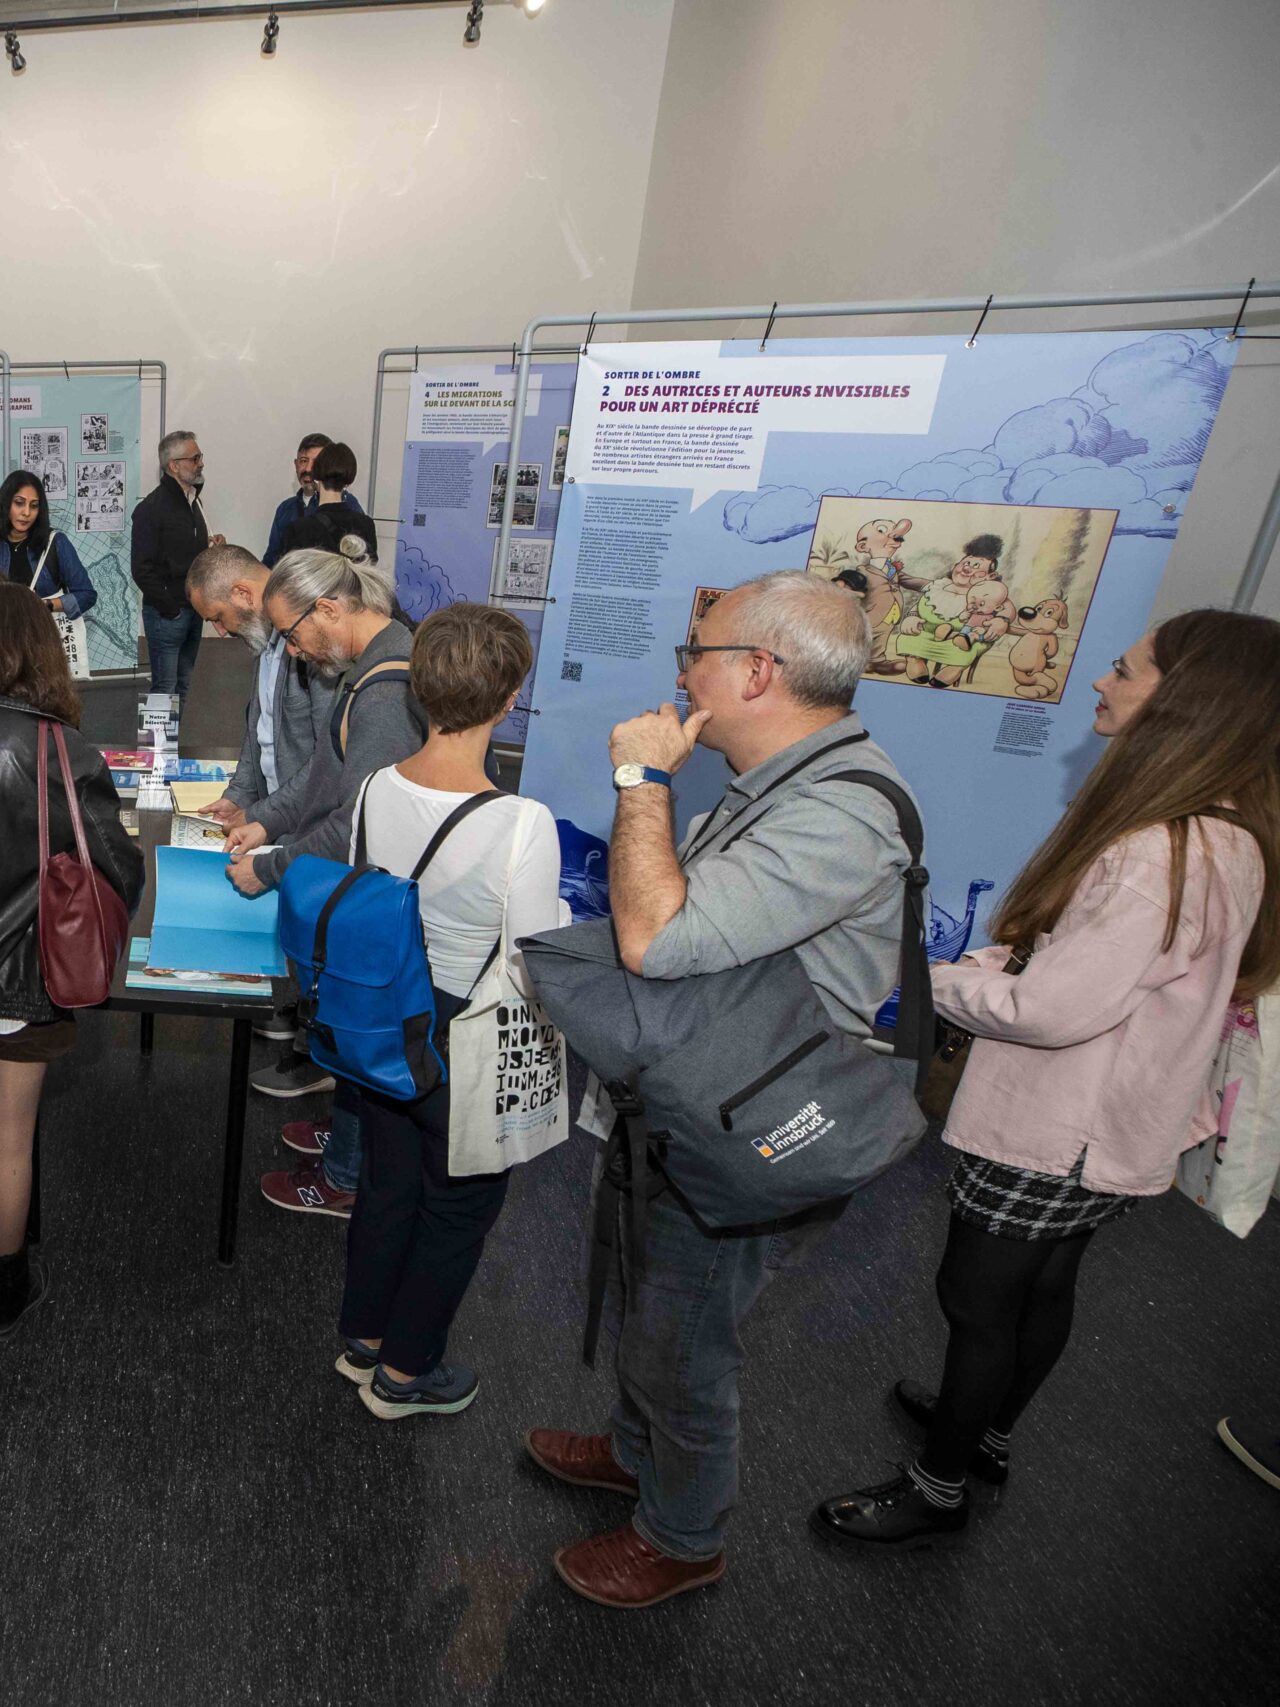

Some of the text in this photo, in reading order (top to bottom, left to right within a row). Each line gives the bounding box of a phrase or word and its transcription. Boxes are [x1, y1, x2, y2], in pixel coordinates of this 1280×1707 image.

[604, 370, 700, 380] SORTIR DE L'OMBRE
[603, 385, 910, 398] 2 DES AUTRICES ET AUTEURS INVISIBLES
[600, 399, 760, 414] POUR UN ART DÉPRÉCIÉ
[765, 1100, 822, 1143] universität
[774, 1113, 826, 1151] innsbruck
[297, 1185, 325, 1206] N
